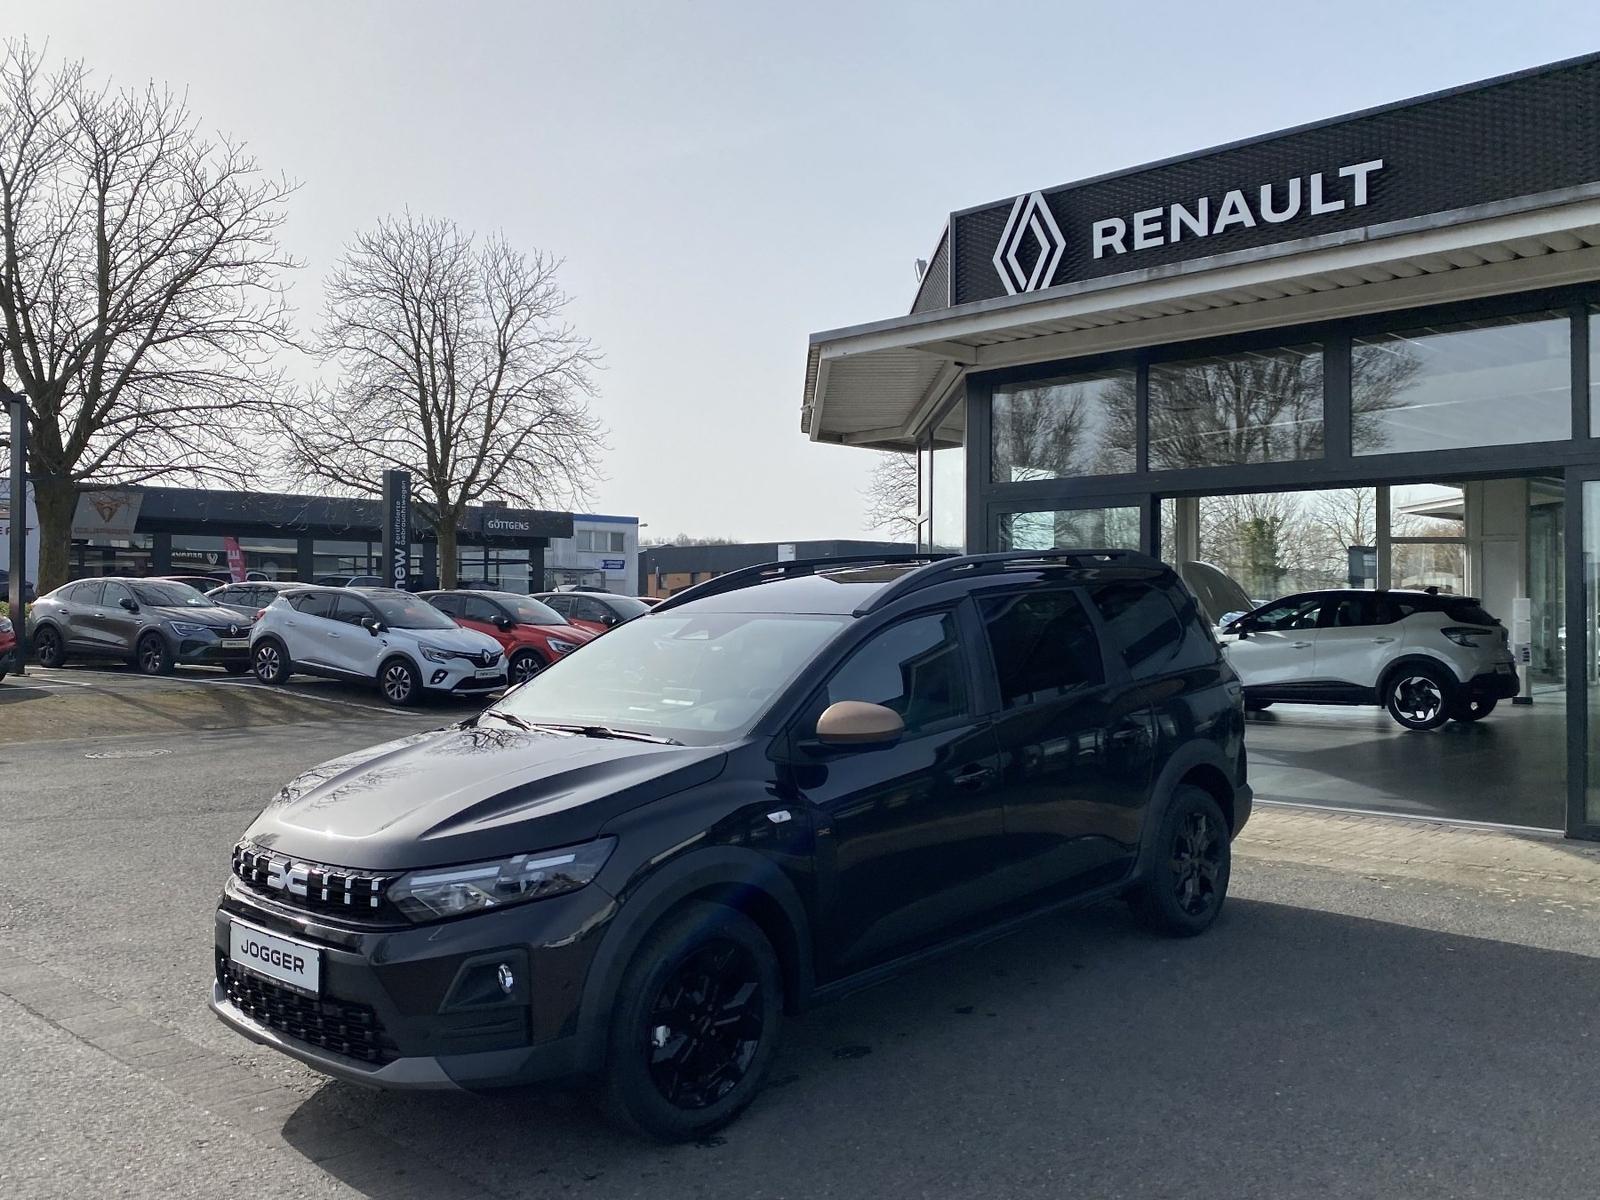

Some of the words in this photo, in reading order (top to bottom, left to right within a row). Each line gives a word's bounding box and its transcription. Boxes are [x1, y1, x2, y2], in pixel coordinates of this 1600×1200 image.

[1092, 158, 1384, 259] RENAULT
[487, 519, 530, 531] GÖTTGENS
[394, 548, 406, 591] new
[240, 939, 305, 975] JOGGER
